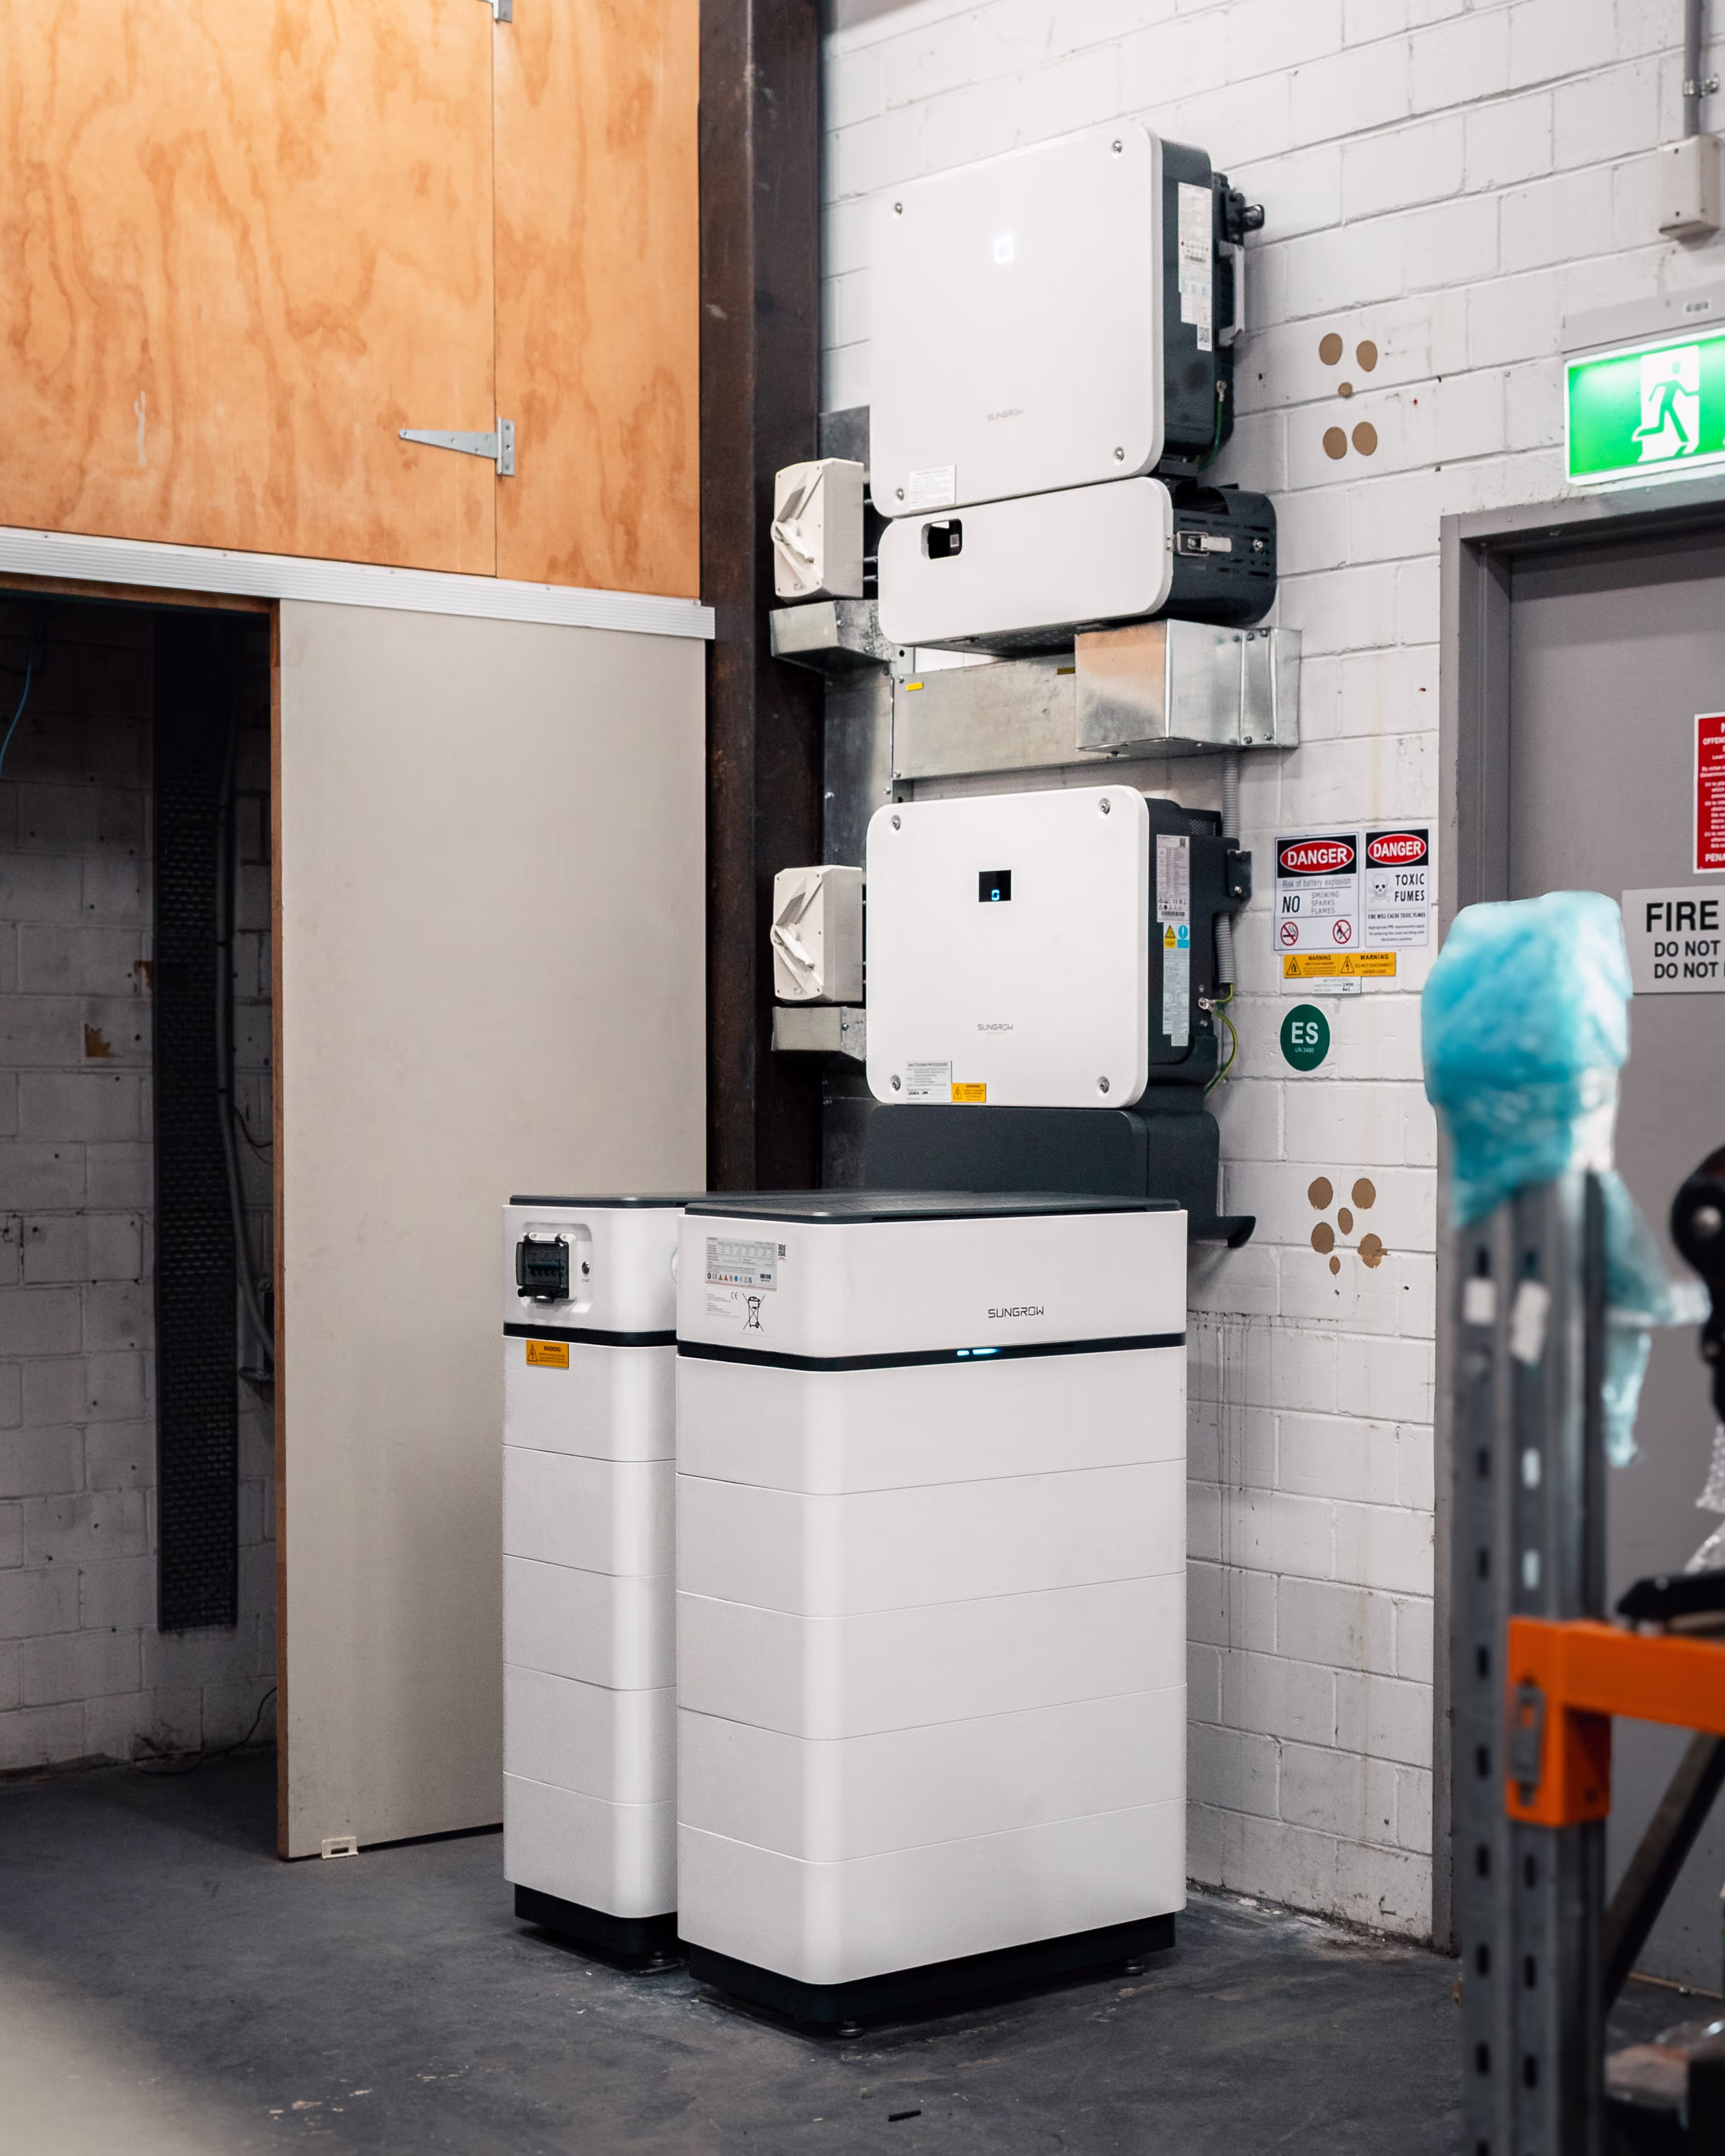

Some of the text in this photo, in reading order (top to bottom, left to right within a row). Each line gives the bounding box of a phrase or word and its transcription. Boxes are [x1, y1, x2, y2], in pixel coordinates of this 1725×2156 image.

[1288, 847, 1348, 866] DANGER
[1374, 841, 1422, 858] DANGER
[1303, 879, 1322, 888] battery
[1395, 873, 1424, 886] TOXIC
[1282, 895, 1300, 913] NO
[1395, 890, 1424, 902] FUMES
[1646, 900, 1719, 933] FIRE
[1654, 940, 1721, 957] DO NOT
[1654, 962, 1719, 978] DO NOT
[1292, 1022, 1318, 1044] ES
[988, 1306, 1044, 1318] SUNGROW
